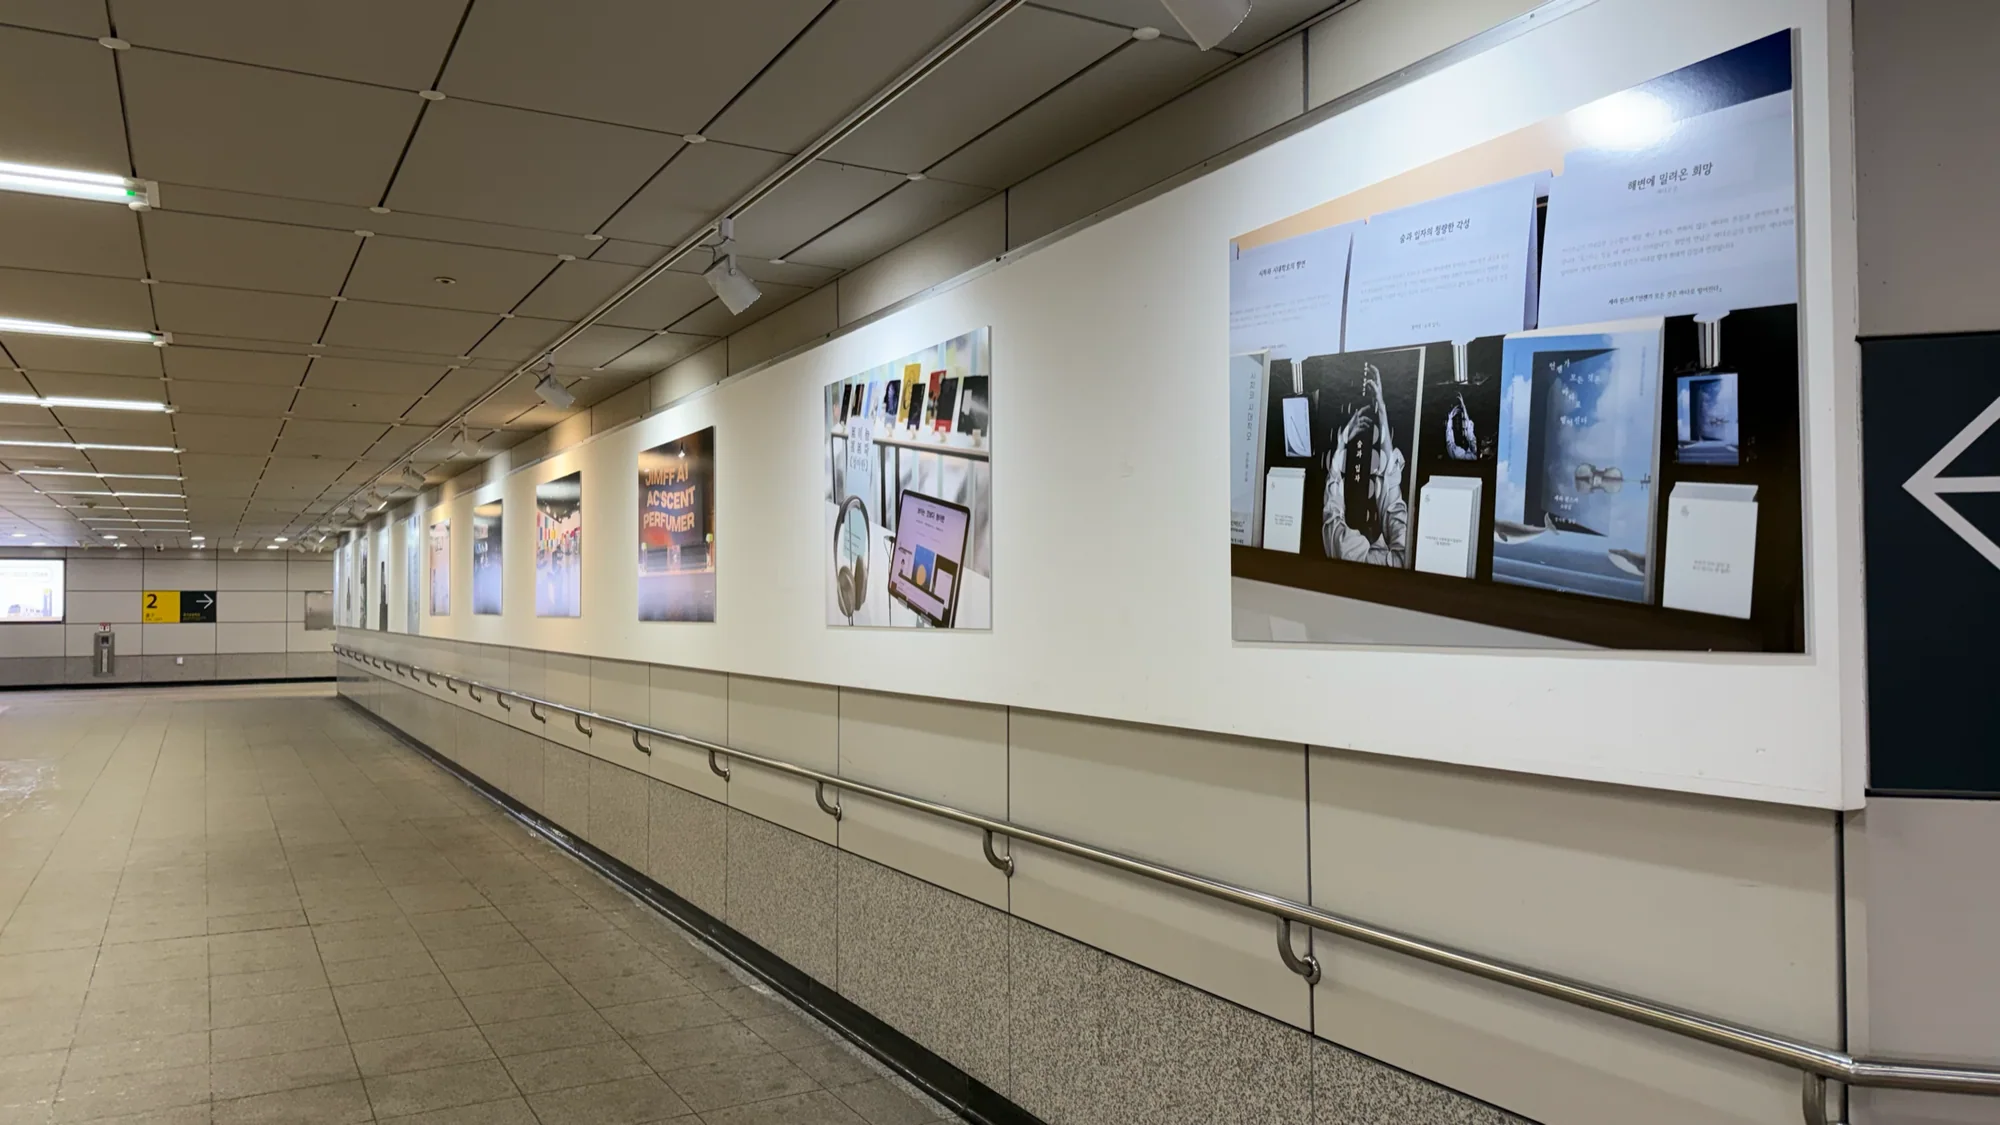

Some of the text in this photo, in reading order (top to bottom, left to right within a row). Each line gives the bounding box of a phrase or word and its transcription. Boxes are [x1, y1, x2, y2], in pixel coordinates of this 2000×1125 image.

[1627, 175, 1656, 191] 해변에
[1659, 167, 1689, 186] 밀려온
[1691, 161, 1714, 177] 희망
[1456, 217, 1471, 230] 각성
[1569, 373, 1584, 384] 모든
[645, 461, 689, 487] JIMFF AI
[1353, 463, 1361, 483] 입자
[643, 511, 695, 533] PERFUMER
[146, 593, 158, 609] 2
